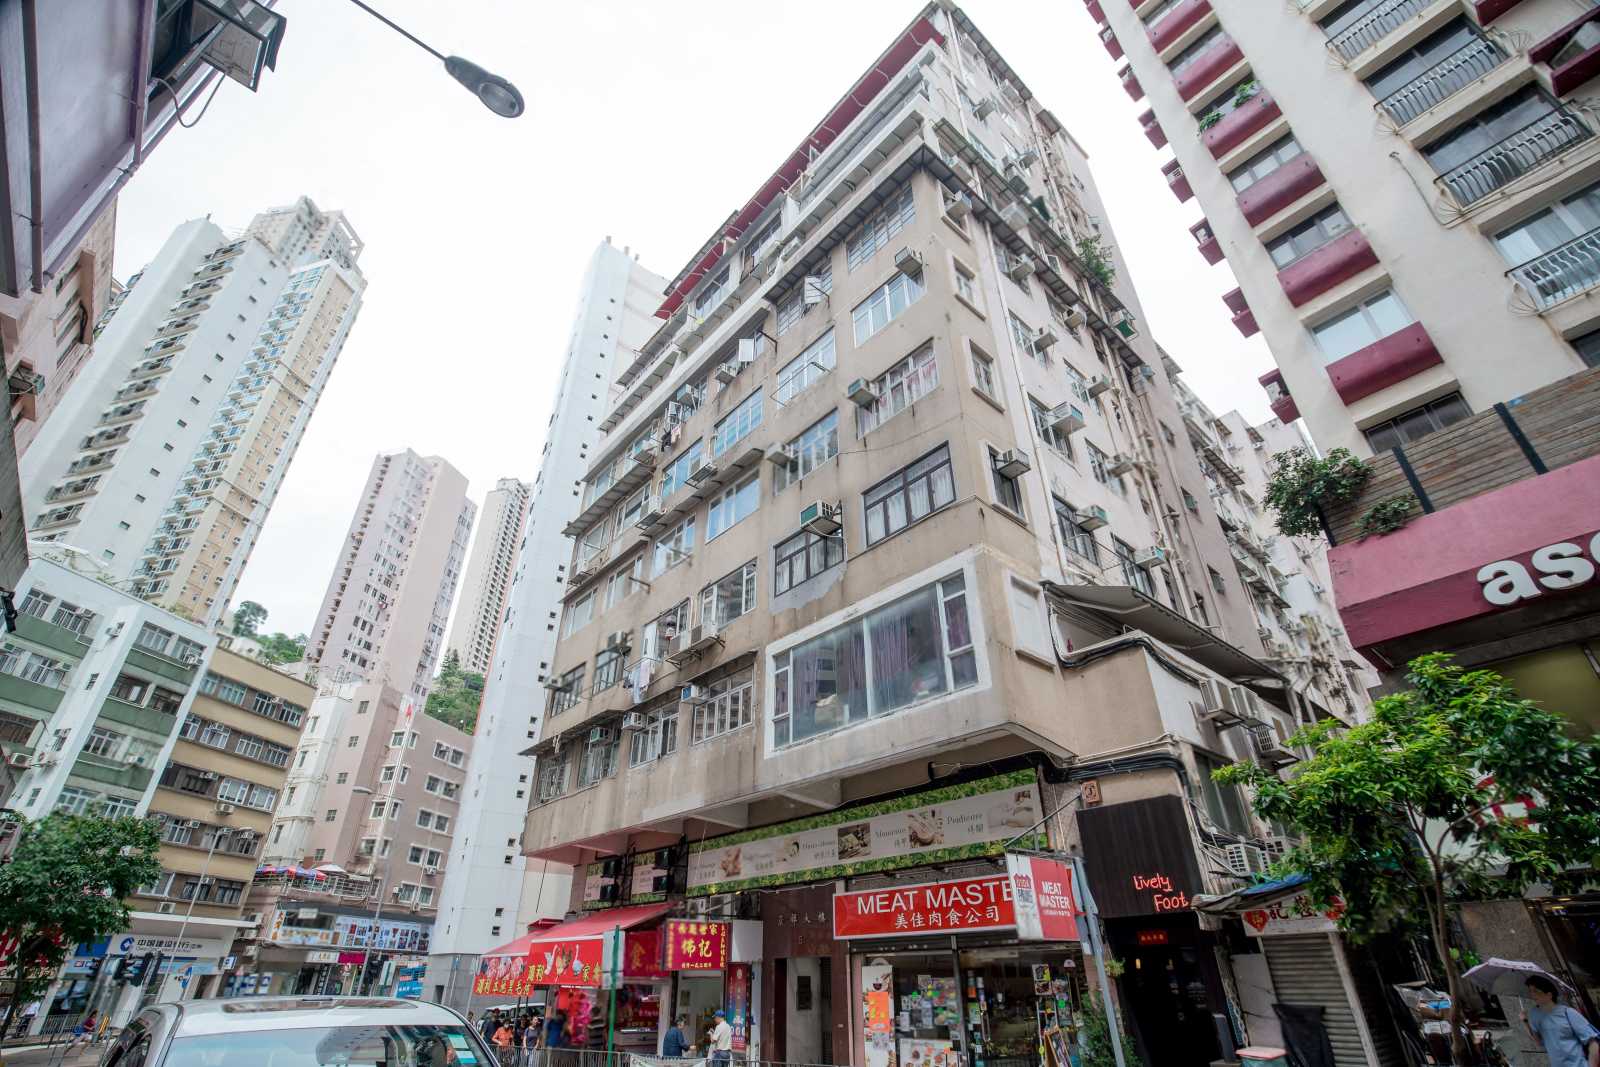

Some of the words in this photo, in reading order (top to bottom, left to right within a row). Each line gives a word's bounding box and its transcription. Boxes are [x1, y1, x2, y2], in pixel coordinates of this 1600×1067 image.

[1477, 531, 1600, 605] as
[1041, 881, 1062, 895] MEAT
[1132, 872, 1173, 892] Lively
[857, 890, 918, 915] MEAT
[925, 880, 1015, 910] MASTE
[1039, 894, 1071, 910] MASTER
[1153, 891, 1189, 912] Foot
[895, 905, 1000, 929] 美佳肉食公司
